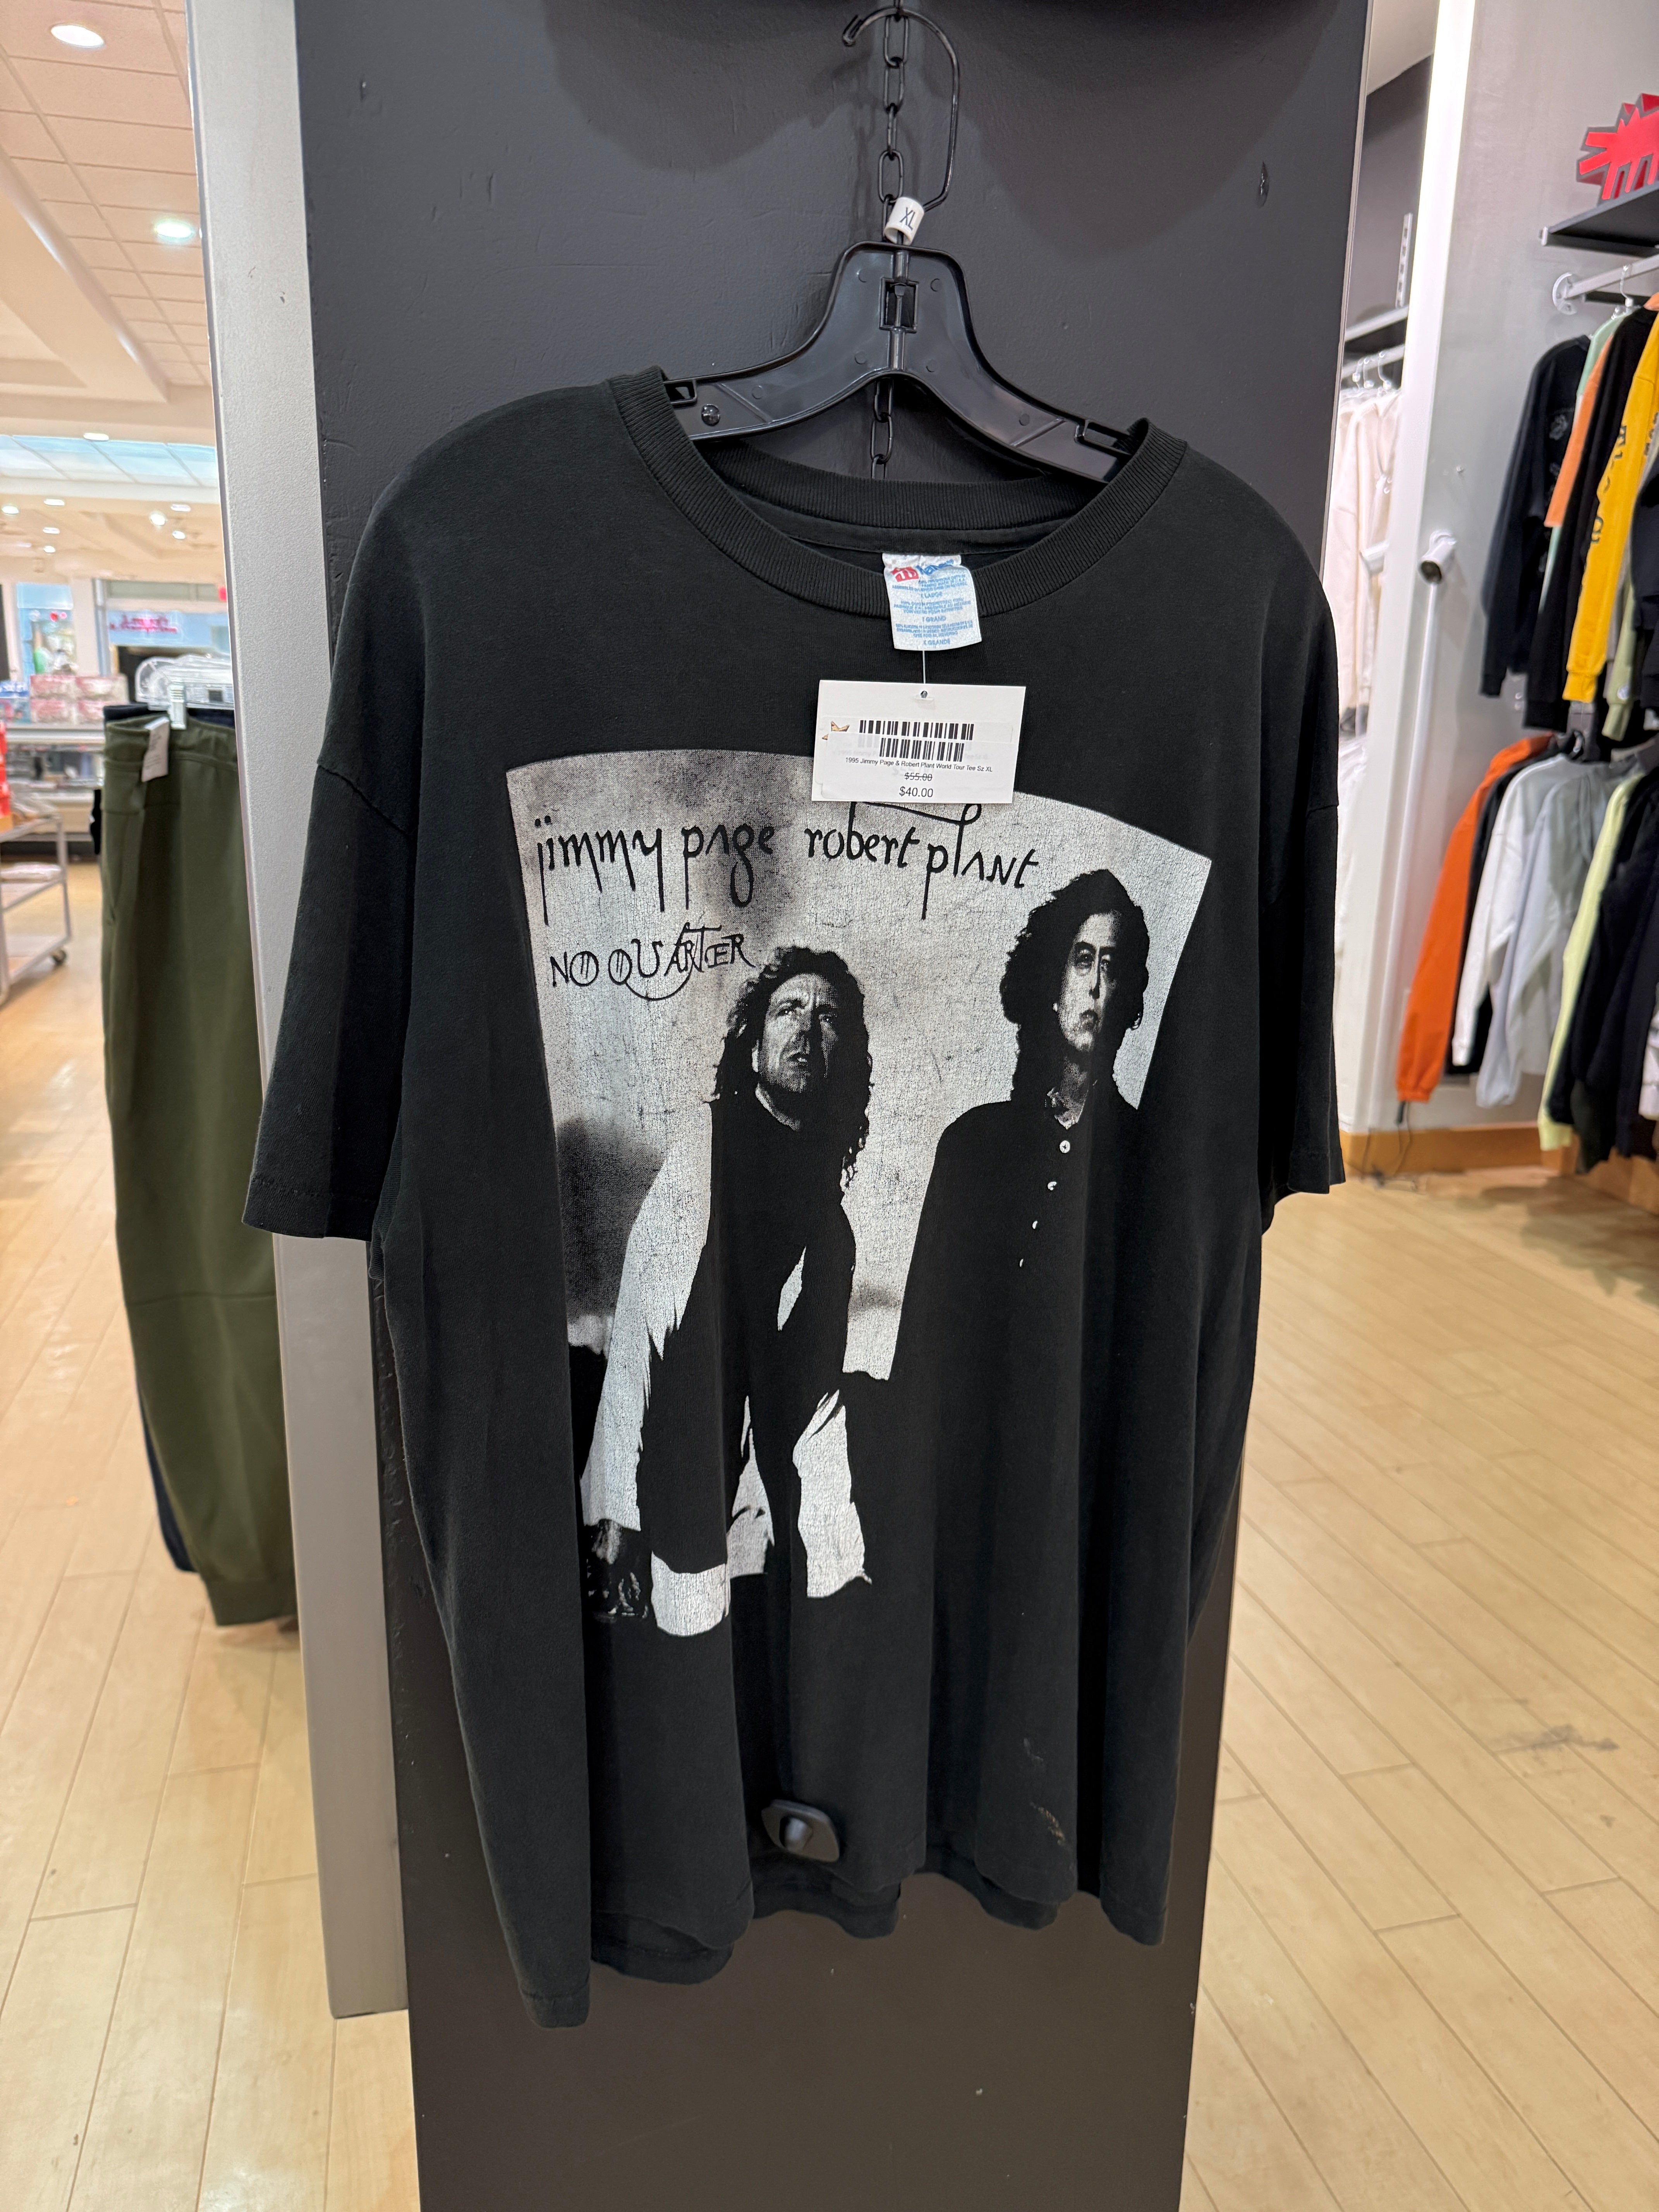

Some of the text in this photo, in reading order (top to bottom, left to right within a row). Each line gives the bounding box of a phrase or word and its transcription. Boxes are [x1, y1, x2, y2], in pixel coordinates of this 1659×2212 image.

[899, 207, 915, 230] XL
[904, 772, 933, 781] $55.00
[899, 786, 933, 797] $40.00
[534, 815, 665, 927] jimmy
[681, 823, 775, 910] page
[804, 802, 920, 868] robert
[549, 922, 756, 1001] NO QUARTER
